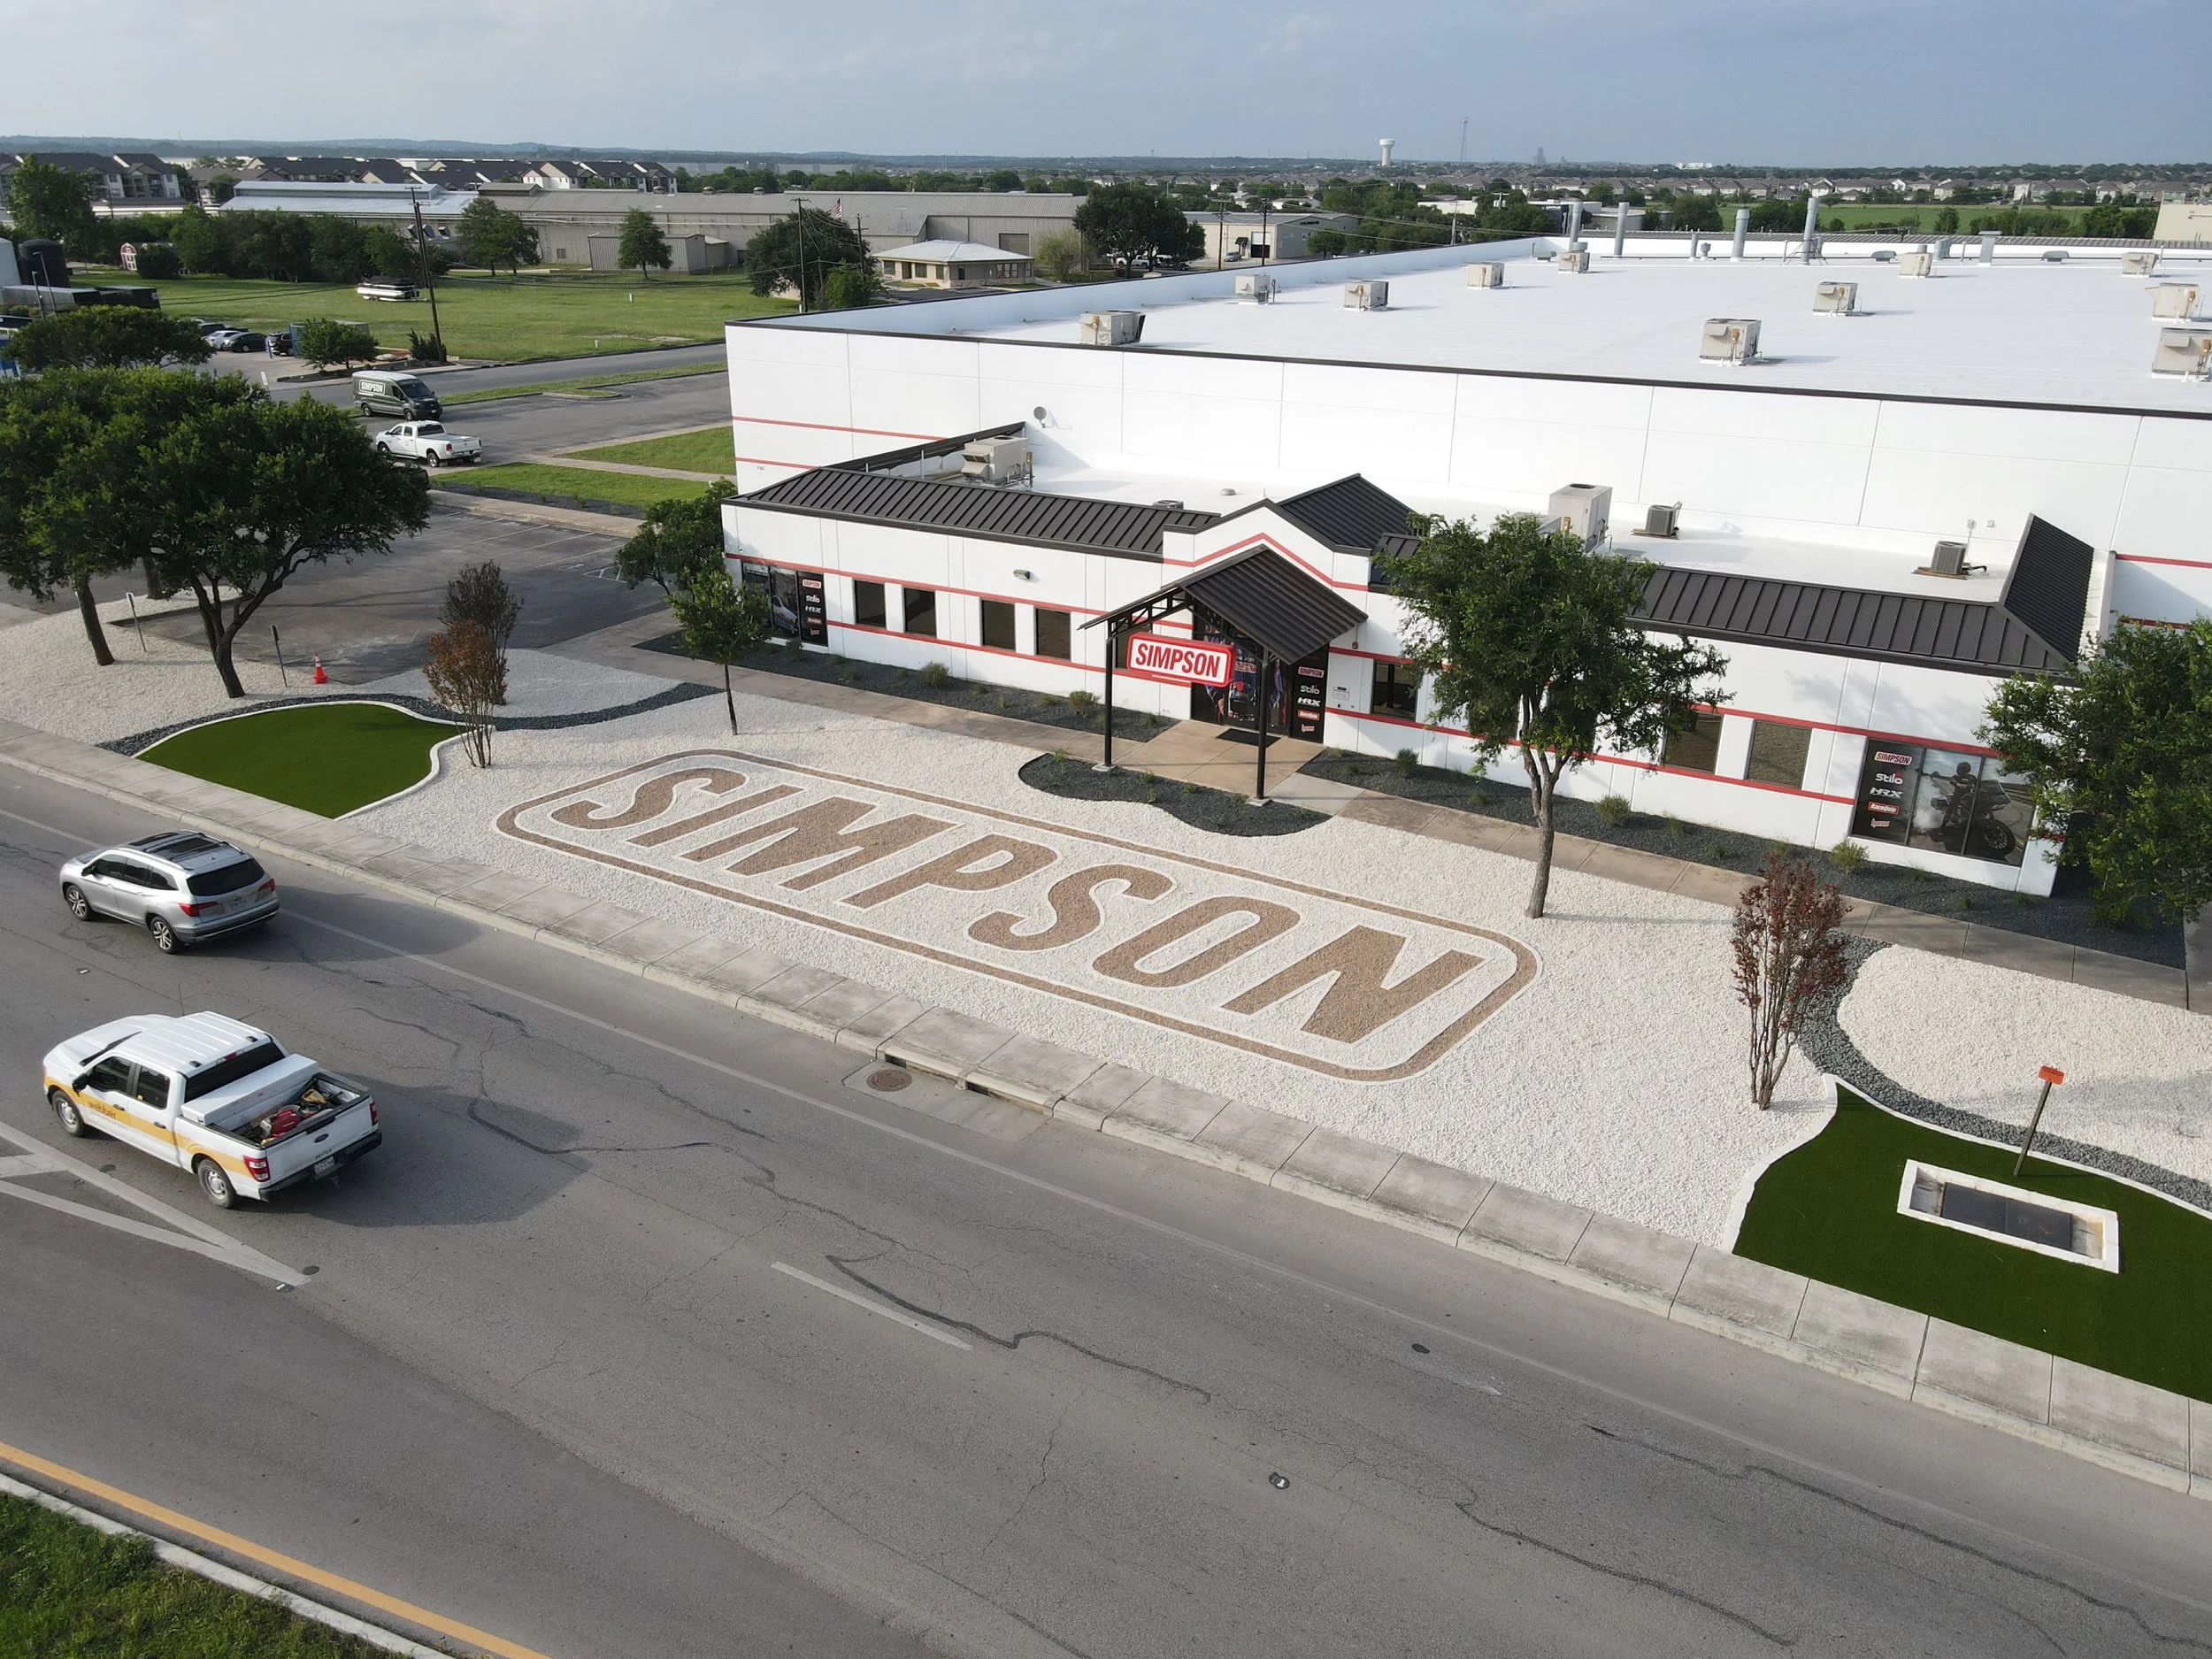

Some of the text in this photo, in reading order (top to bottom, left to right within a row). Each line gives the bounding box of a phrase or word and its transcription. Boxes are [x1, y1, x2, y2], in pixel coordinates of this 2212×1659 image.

[1135, 643, 1221, 678] SIMPSON
[1876, 752, 1910, 764] SIMPSON
[1875, 772, 1903, 785] Stilo
[550, 767, 1486, 1044] SIMPSON
